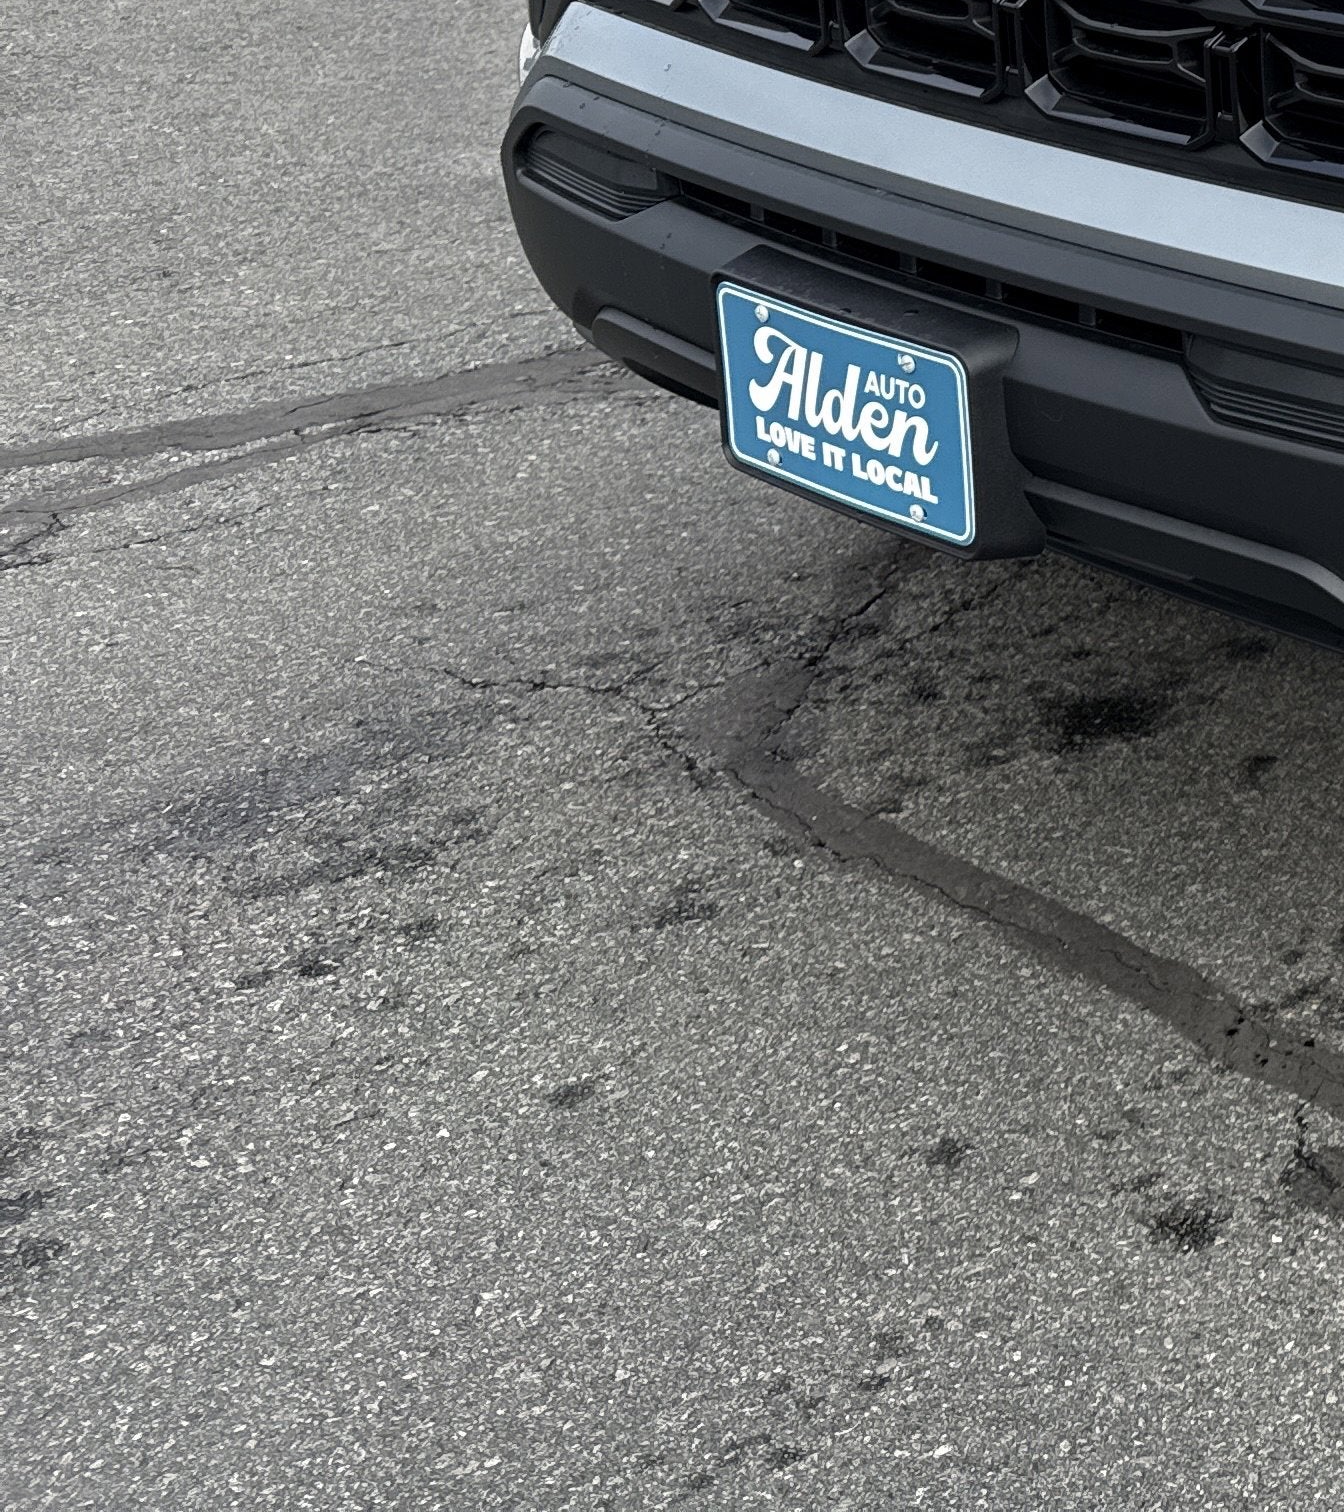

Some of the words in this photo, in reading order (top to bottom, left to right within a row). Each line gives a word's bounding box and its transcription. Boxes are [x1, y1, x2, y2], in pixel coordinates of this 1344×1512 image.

[748, 326, 939, 466] Alden
[864, 371, 926, 410] AUTO
[756, 416, 817, 461] LOVE
[822, 441, 846, 471] IT
[852, 453, 939, 504] LOCAL
